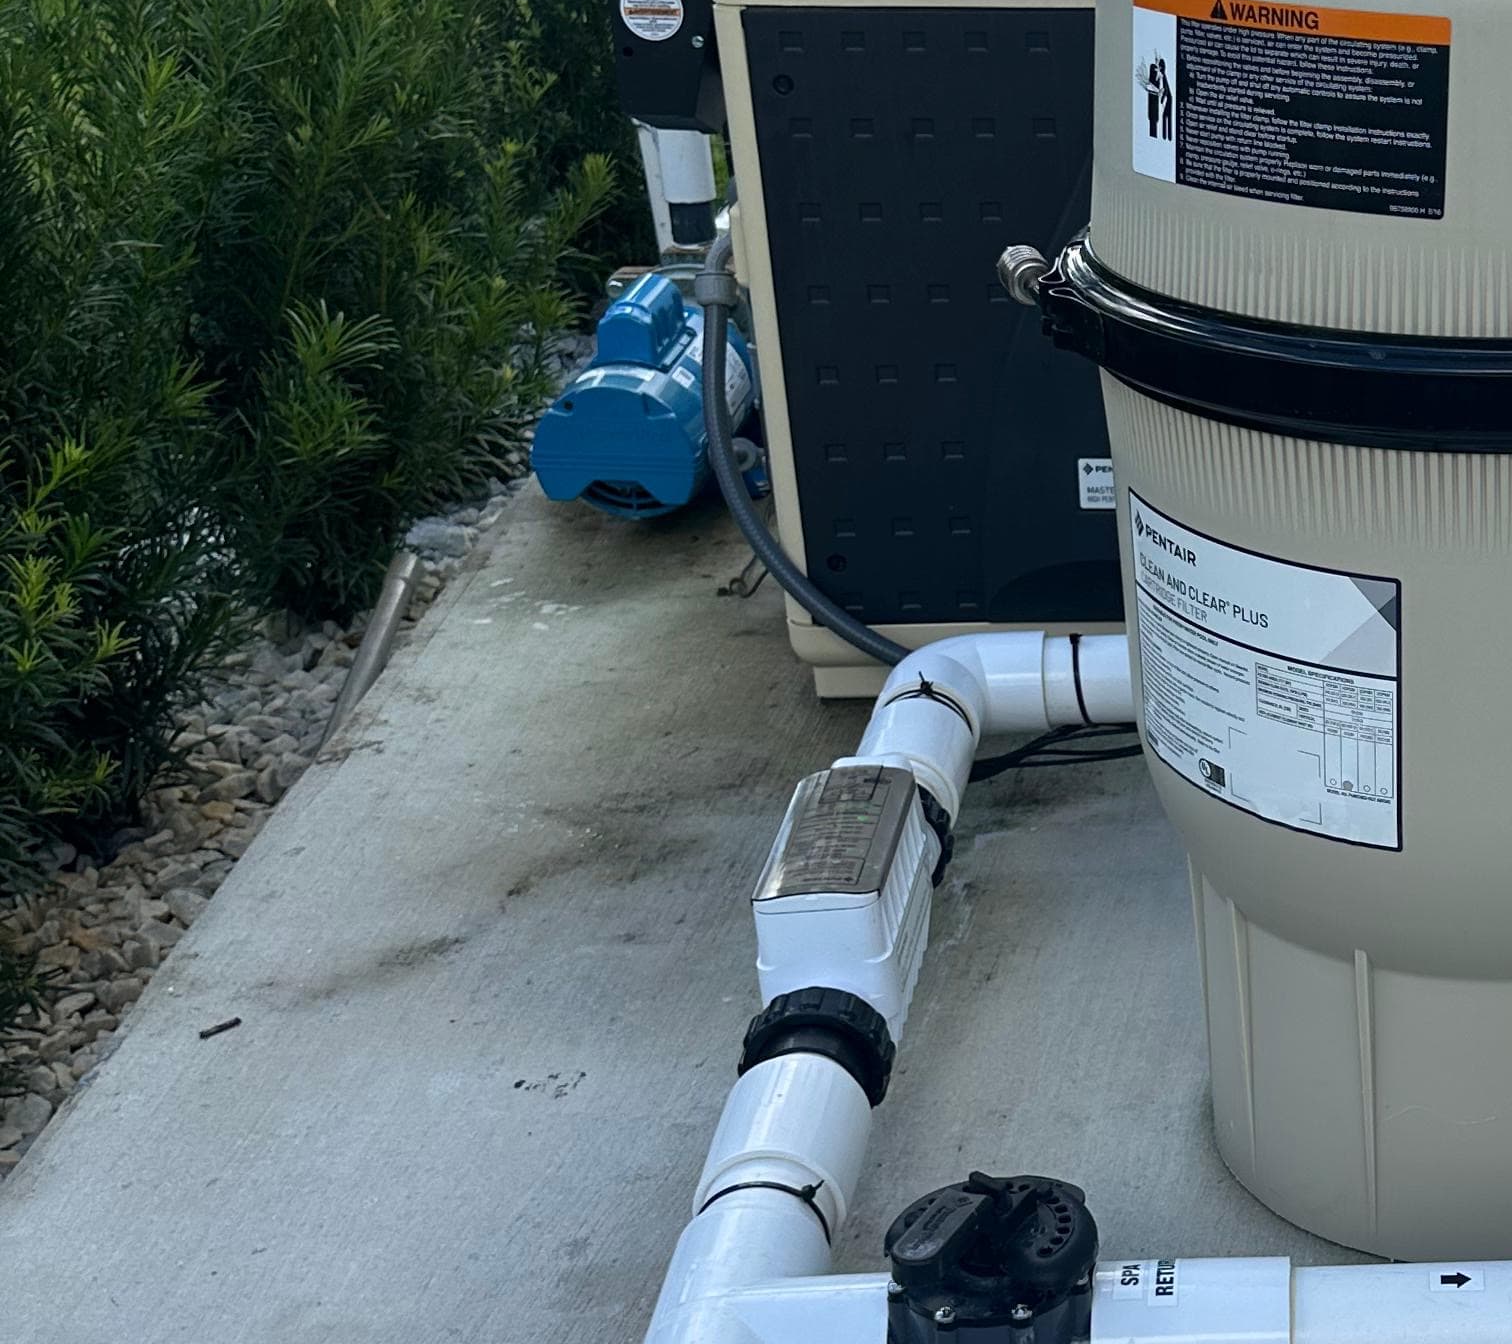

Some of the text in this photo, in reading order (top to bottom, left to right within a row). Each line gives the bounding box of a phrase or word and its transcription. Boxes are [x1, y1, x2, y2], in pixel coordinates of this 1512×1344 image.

[1229, 2, 1320, 30] WARNING
[1145, 523, 1197, 567] PENTAIR
[1140, 552, 1165, 582] CLEAN
[1166, 574, 1187, 596] AND
[1232, 604, 1269, 628] PLUS
[1177, 598, 1208, 623] FILTER
[1120, 1264, 1141, 1286] SPA
